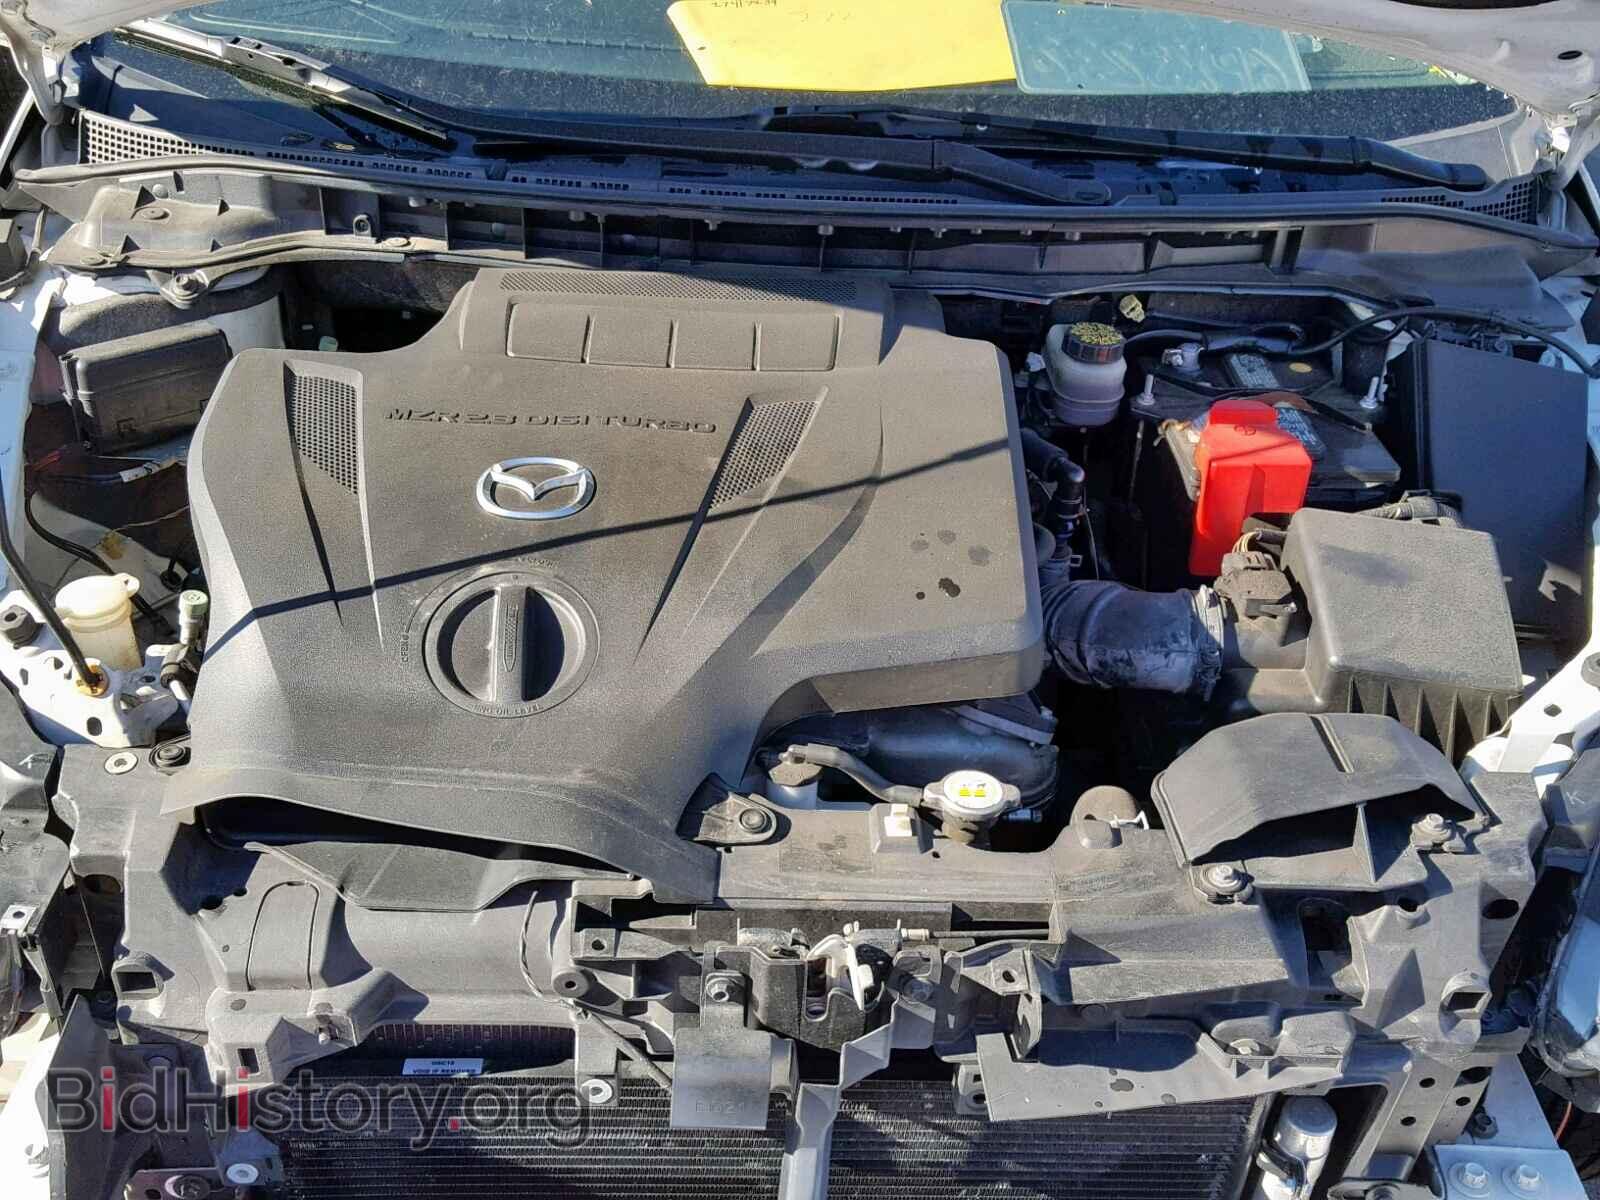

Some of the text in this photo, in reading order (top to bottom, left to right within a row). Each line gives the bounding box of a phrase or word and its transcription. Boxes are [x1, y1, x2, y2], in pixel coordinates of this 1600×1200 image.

[384, 408, 460, 424] MZR
[527, 414, 590, 427] DISI
[599, 414, 717, 434] TURBO
